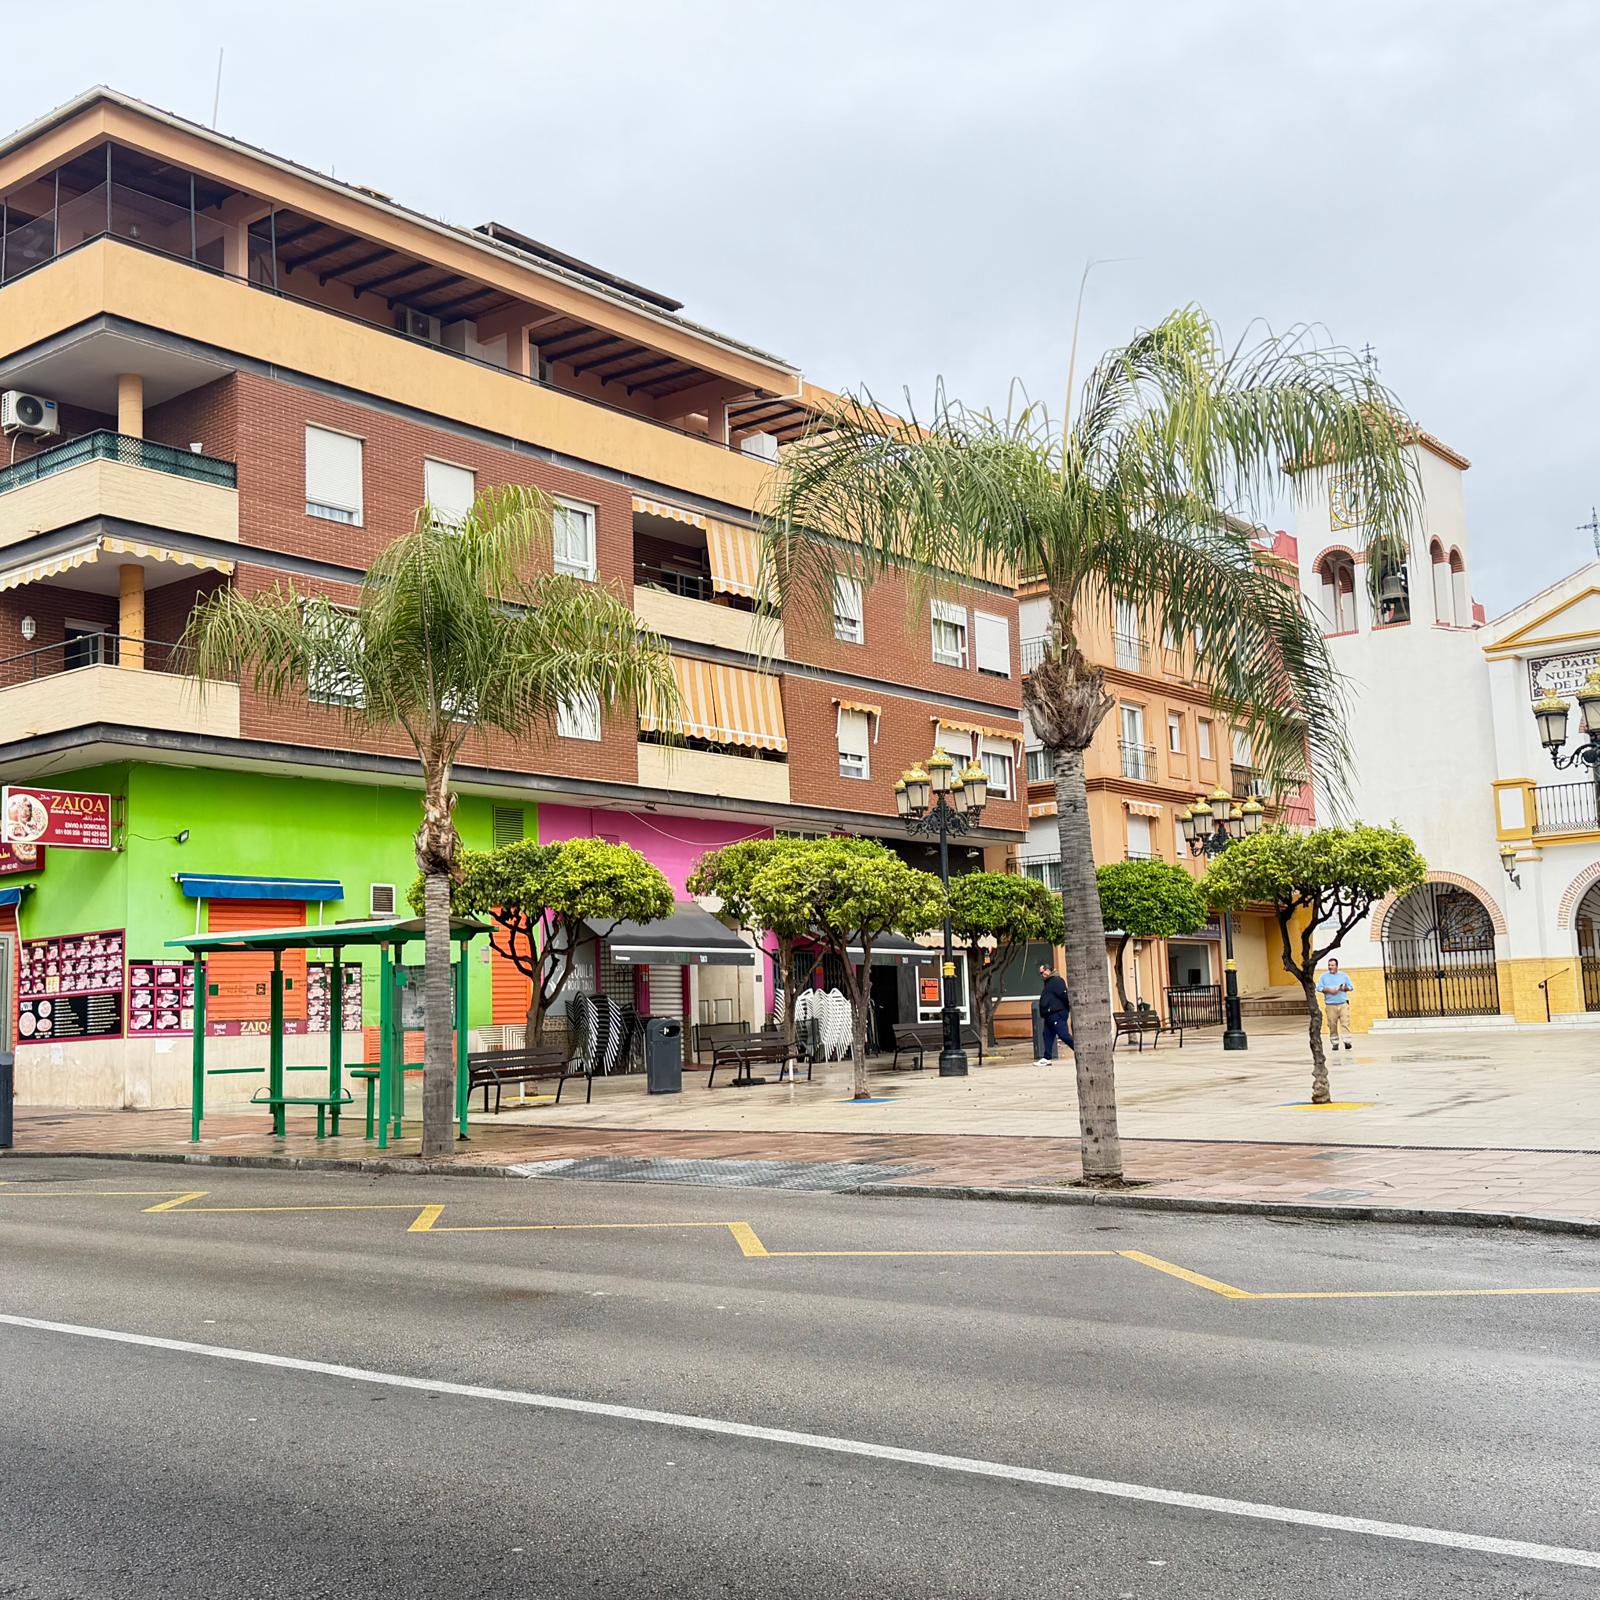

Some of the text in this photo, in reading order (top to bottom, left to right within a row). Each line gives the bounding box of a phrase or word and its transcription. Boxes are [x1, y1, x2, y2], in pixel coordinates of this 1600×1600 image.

[1545, 667, 1598, 682] NUEST
[1554, 681, 1571, 690] DE
[51, 796, 106, 814] ZAIQA
